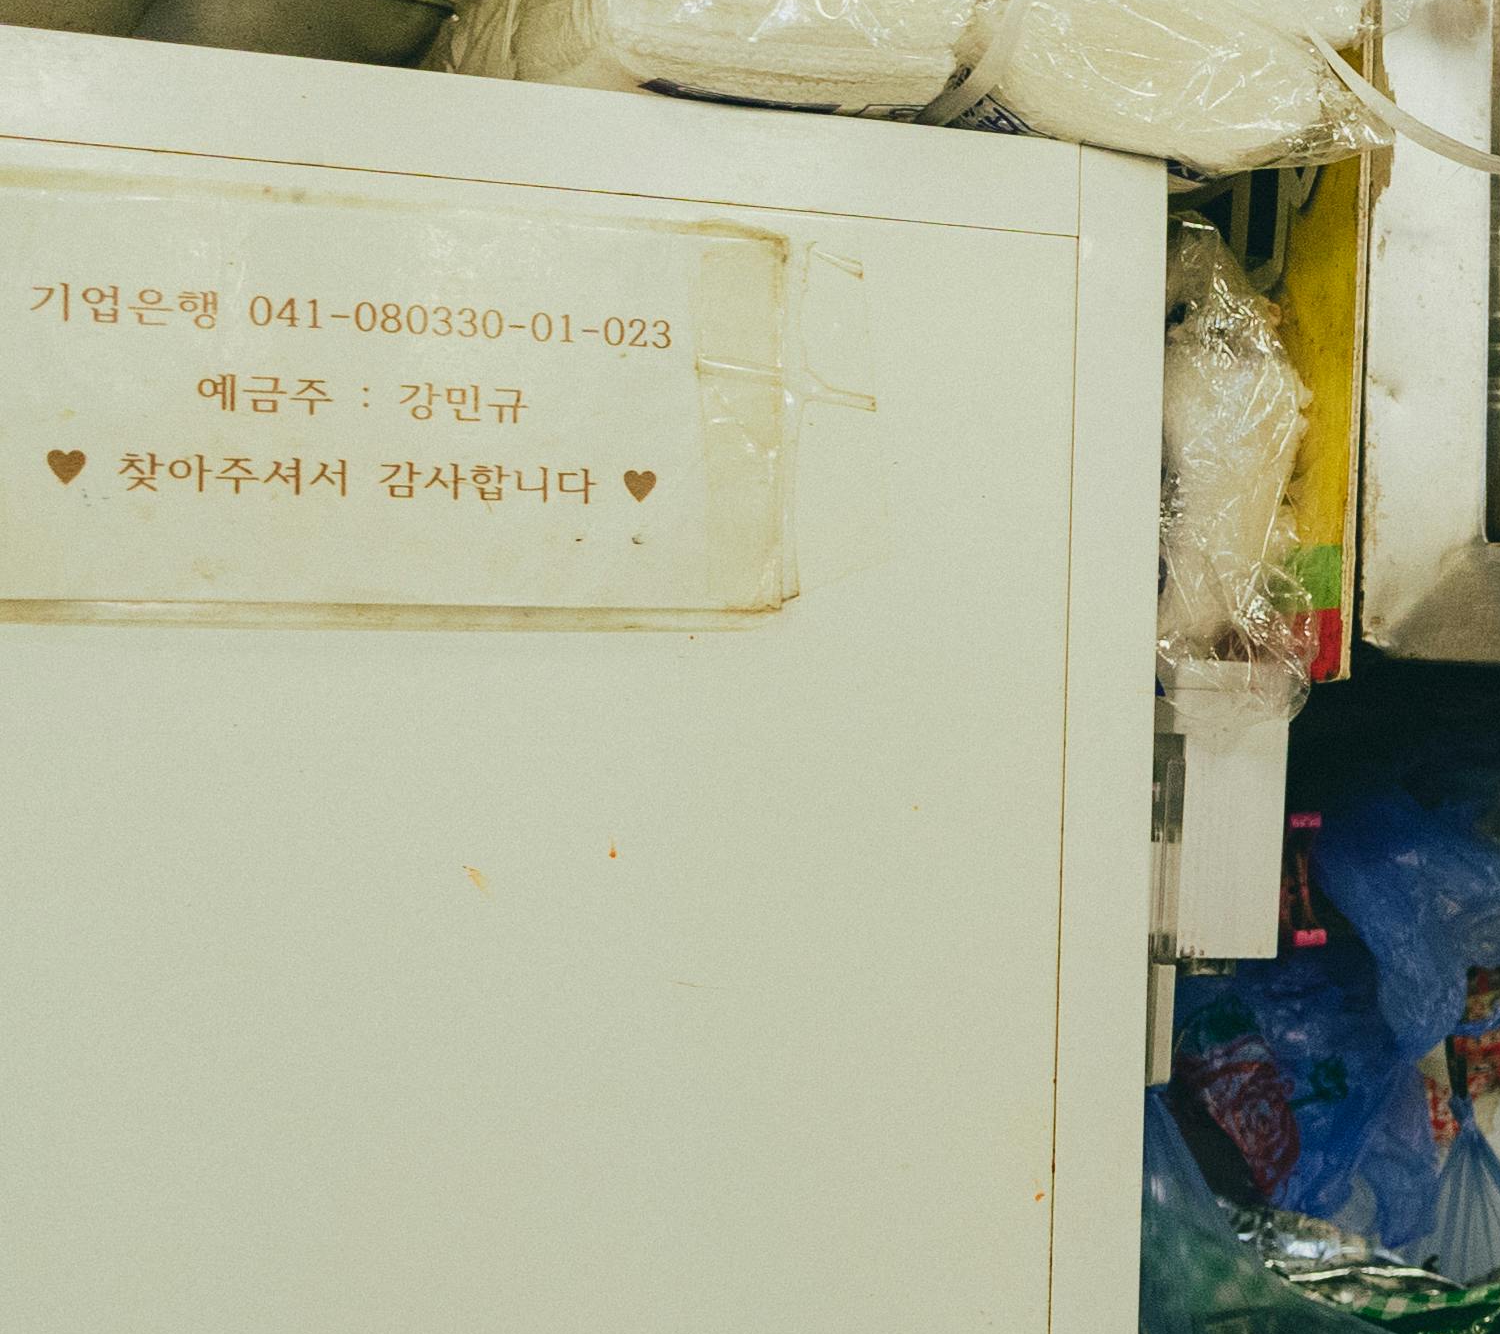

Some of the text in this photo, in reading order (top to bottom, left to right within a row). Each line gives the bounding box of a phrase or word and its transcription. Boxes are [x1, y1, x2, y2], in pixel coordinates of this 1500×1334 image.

[29, 282, 674, 350] 기업은행 041-080330-01-023
[197, 374, 335, 417] 예금주
[398, 380, 530, 425] 강민규
[117, 451, 599, 506] 찾아주셔서 감사합니다
